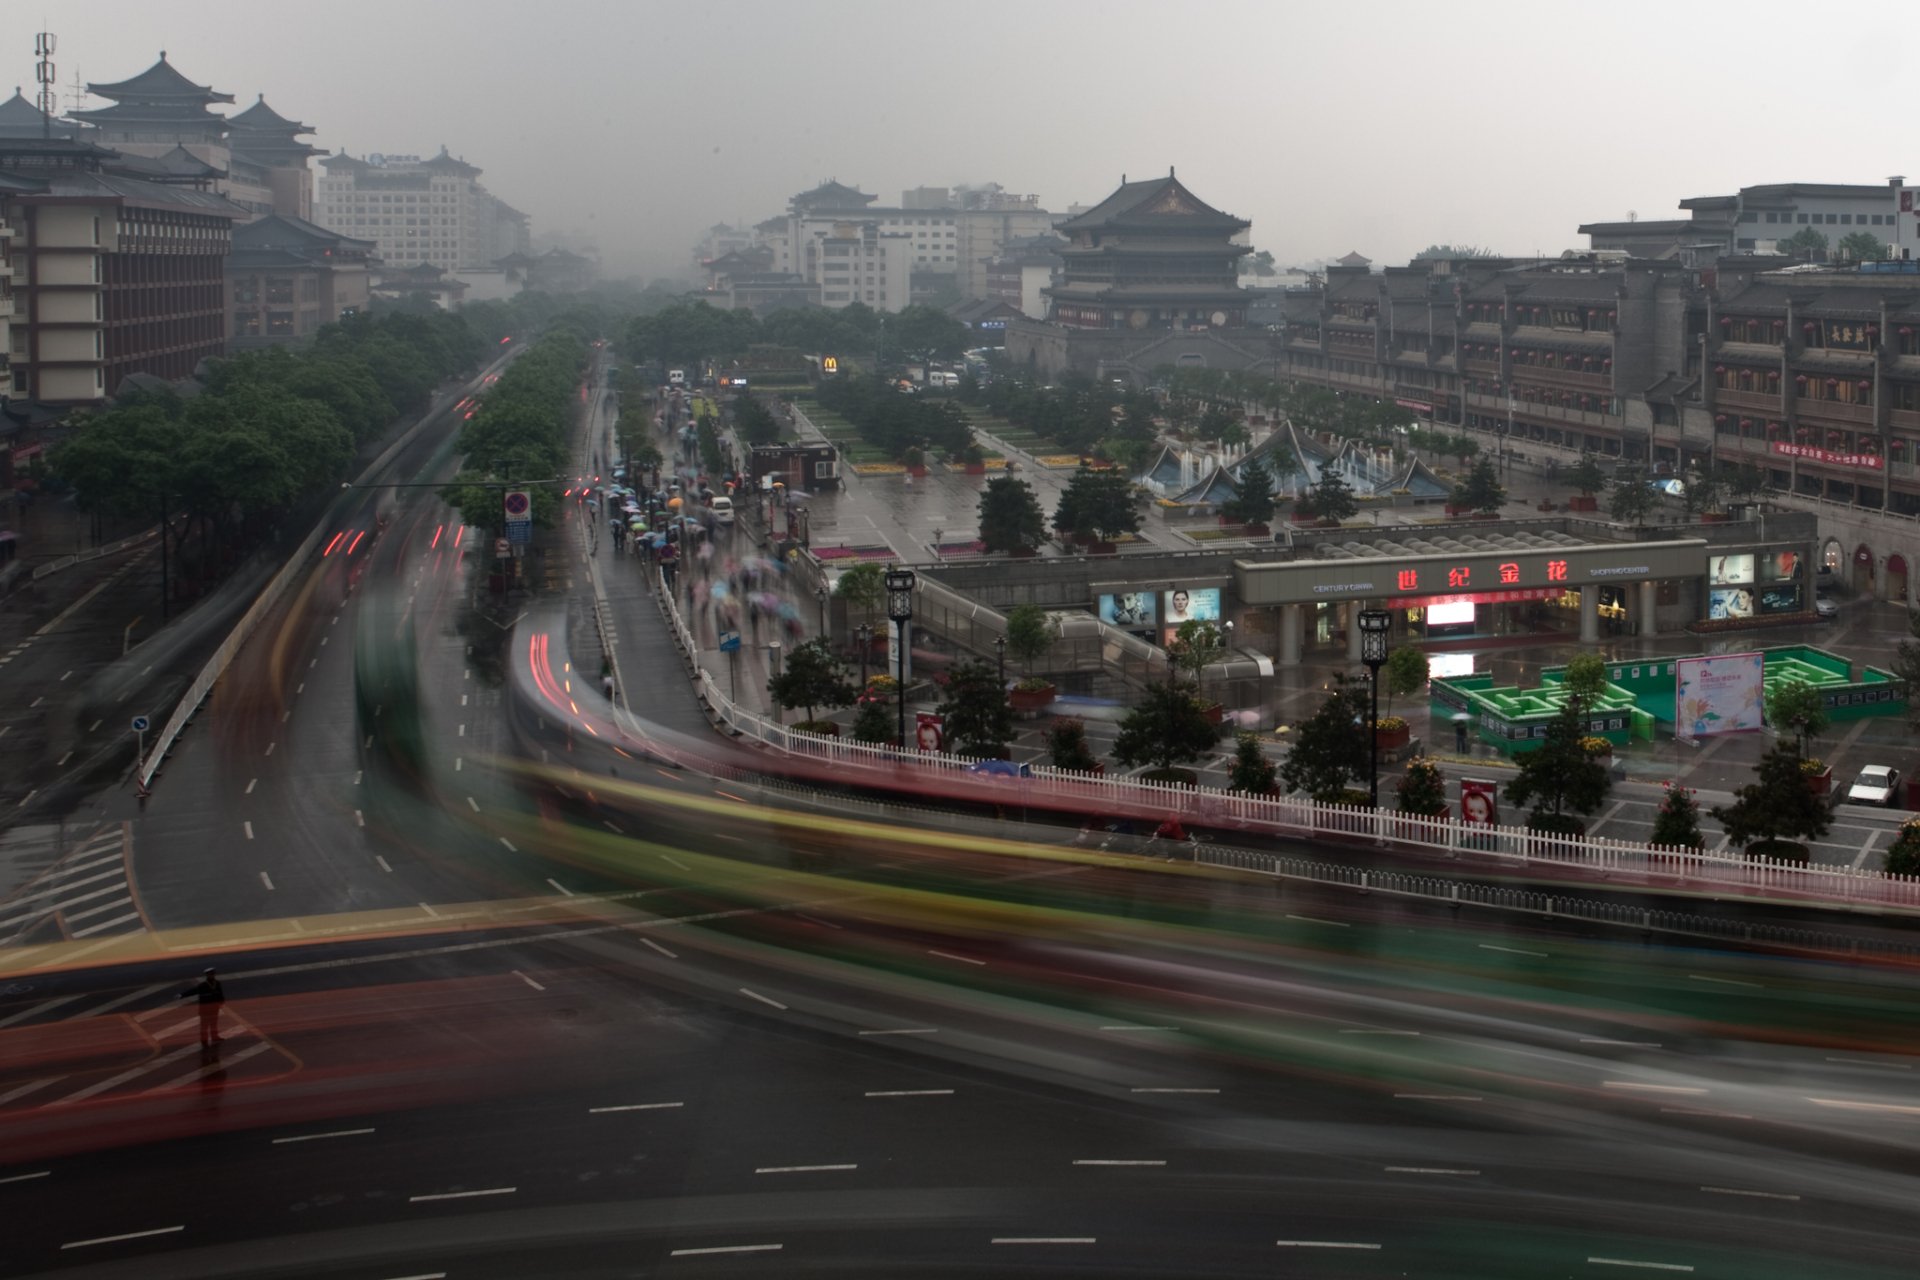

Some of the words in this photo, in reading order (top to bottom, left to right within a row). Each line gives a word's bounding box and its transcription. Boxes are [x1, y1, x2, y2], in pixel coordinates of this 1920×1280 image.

[1397, 560, 1568, 591] 世纪金花
[1313, 584, 1349, 593] CENTURY
